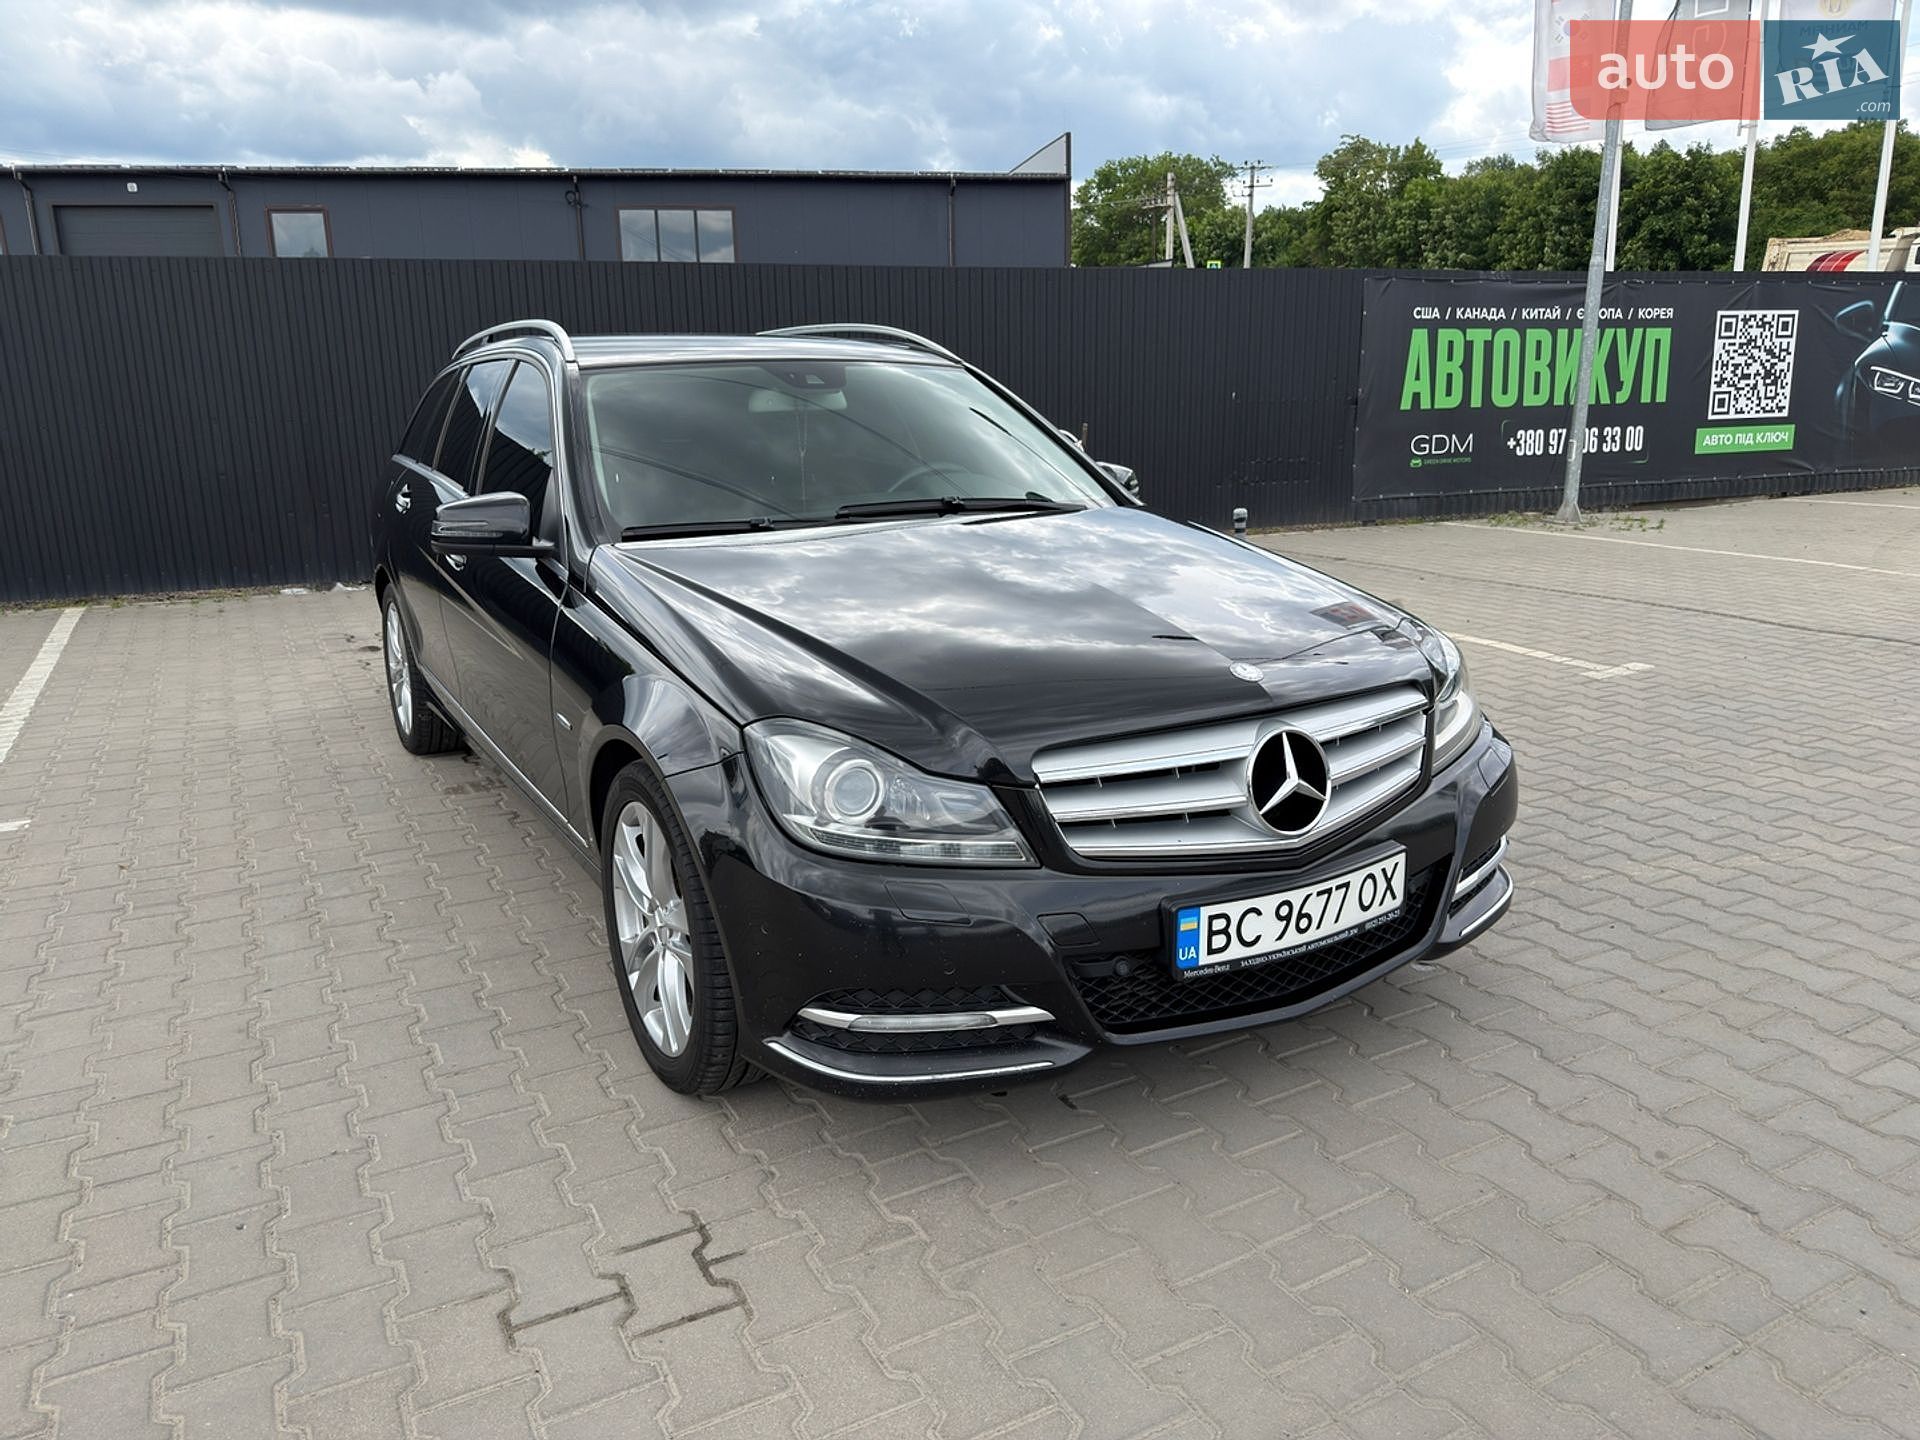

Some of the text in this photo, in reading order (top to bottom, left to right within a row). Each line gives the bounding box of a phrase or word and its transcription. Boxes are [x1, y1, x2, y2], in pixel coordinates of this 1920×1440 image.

[1413, 307, 1441, 320] США
[1455, 306, 1507, 322] КАНАДА
[1521, 305, 1562, 320] КИТАЙ
[1576, 308, 1624, 320] ЄОПА
[1638, 308, 1674, 319] КОРЕЯ
[1400, 327, 1672, 411] АВТОВИКУП
[1410, 433, 1474, 456] GDM
[1507, 429, 1544, 456] +380
[1548, 428, 1567, 455] 97
[1602, 426, 1622, 453] 33
[1625, 425, 1644, 452] 00
[1702, 431, 1789, 446] АВТО ПІД КЛЮЧ
[1206, 907, 1263, 956] BC
[1274, 881, 1351, 942] 9677
[1358, 862, 1400, 912] OX
[1178, 946, 1197, 961] UA
